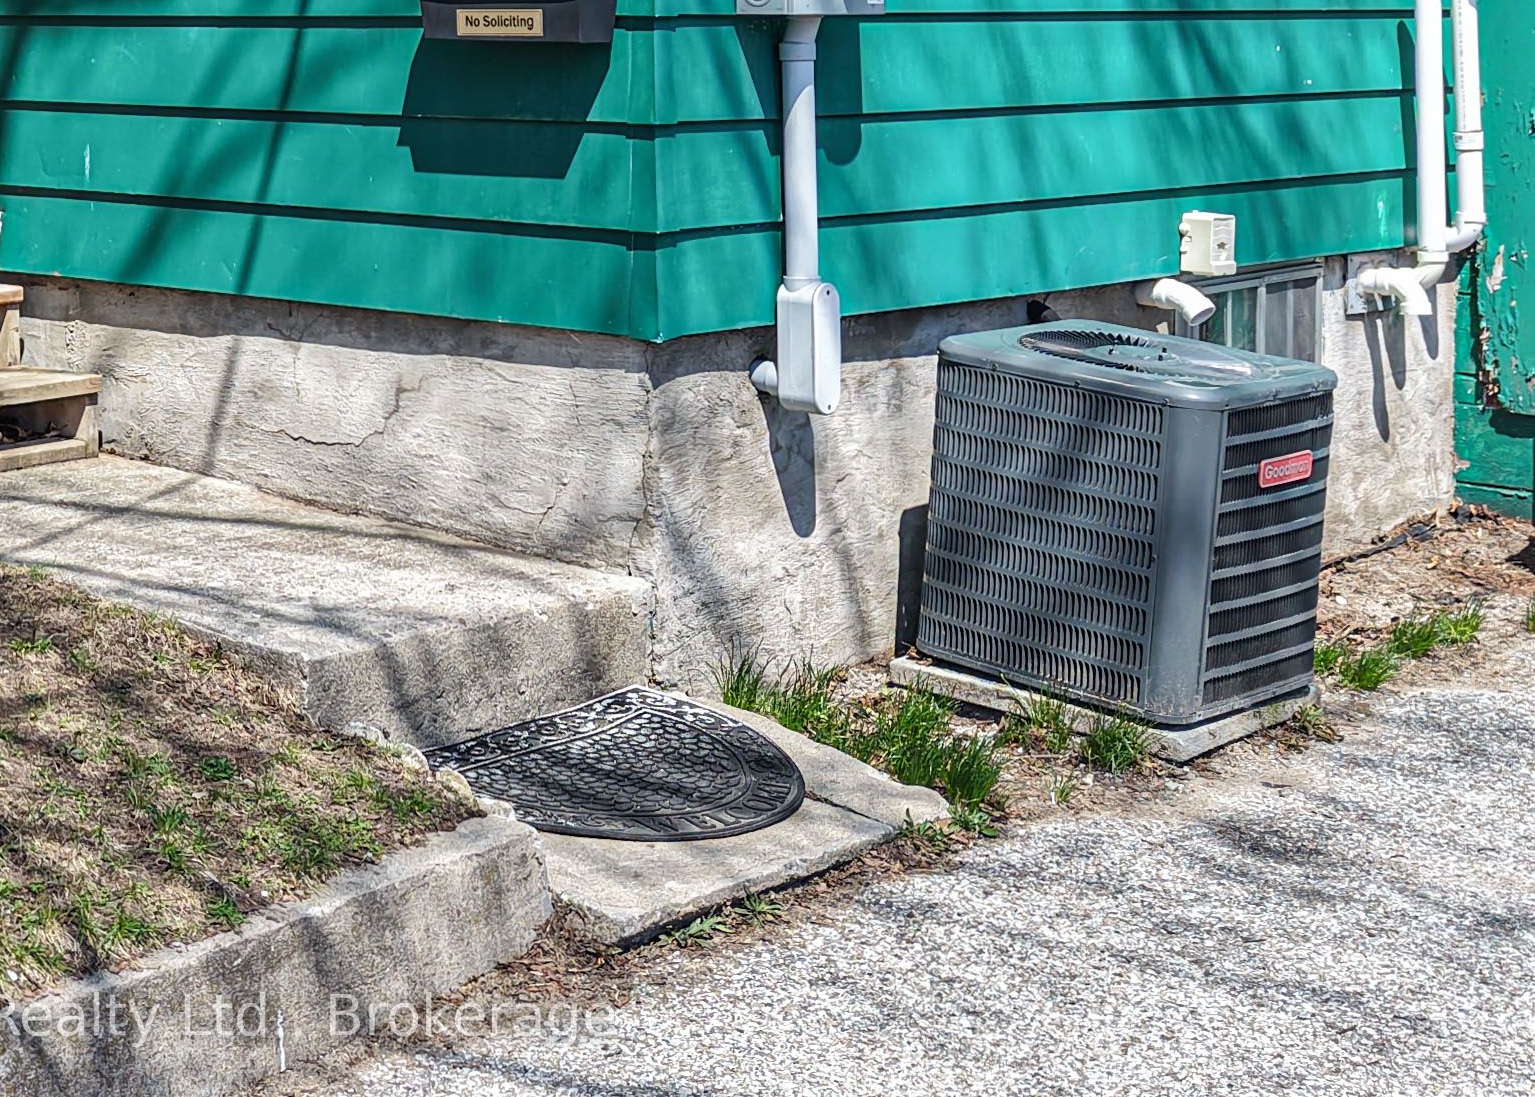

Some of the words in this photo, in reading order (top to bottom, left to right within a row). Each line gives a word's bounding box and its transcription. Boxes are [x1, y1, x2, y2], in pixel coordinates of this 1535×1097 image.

[465, 15, 480, 28] No
[483, 15, 534, 31] Soliciting
[1265, 460, 1309, 480] Goodman
